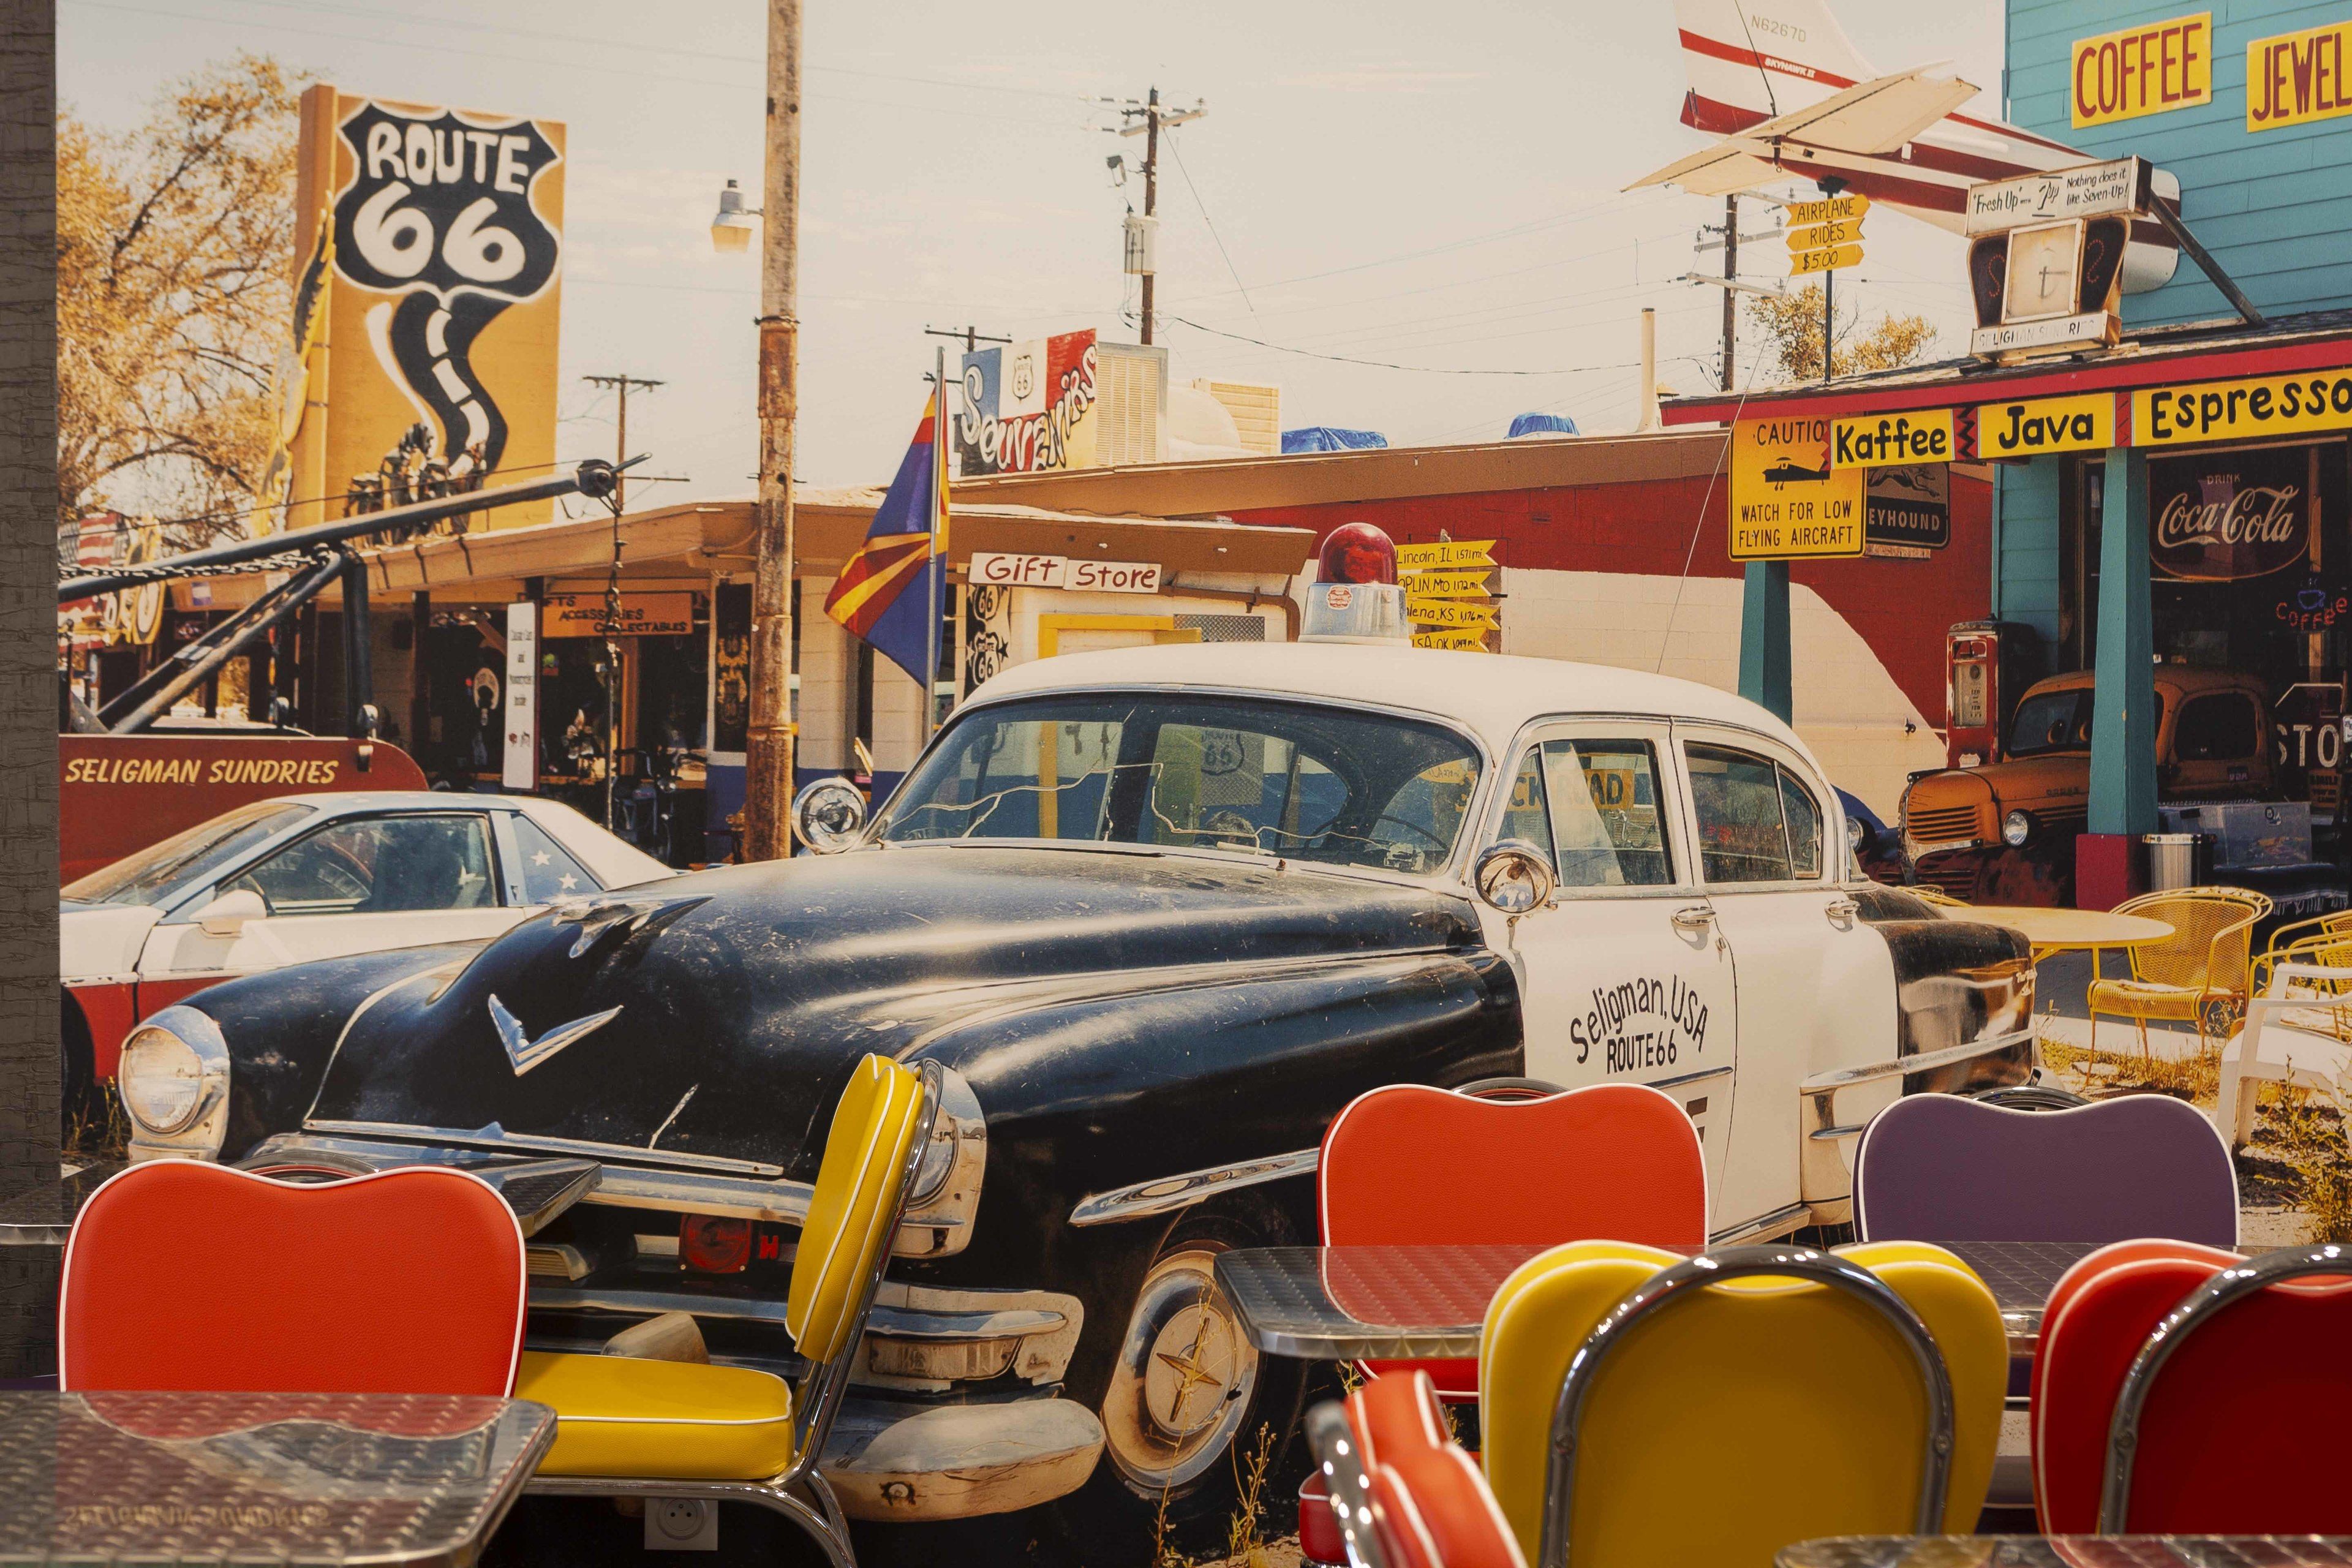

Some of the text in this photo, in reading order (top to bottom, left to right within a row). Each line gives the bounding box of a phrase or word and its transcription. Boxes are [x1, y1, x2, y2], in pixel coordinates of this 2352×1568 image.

[1751, 15, 1806, 42] N6267D
[2076, 23, 2203, 118] COFFEE
[2252, 32, 2352, 121] JEWEL
[368, 121, 531, 195] ROUTE
[2067, 167, 2127, 189] Nothing does it
[1796, 197, 1855, 222] AIRPLANE
[2067, 193, 2080, 206] like
[352, 181, 526, 283] 66
[1810, 223, 1845, 246] RIDES
[2150, 378, 2352, 439] Espresso
[1756, 419, 1825, 446] CAUTIO
[1837, 418, 1947, 464] Kaffee
[1999, 405, 2094, 450] Java
[2207, 473, 2241, 485] DRINK
[1741, 499, 1852, 523] WATCH FOR LOW
[1868, 508, 1940, 531] EYHOUND
[1738, 526, 1853, 548] FLYING AIRCRAFT
[984, 556, 1157, 589] Gift Store
[978, 590, 993, 613] 66
[1440, 607, 1455, 622] KS
[978, 656, 993, 678] 66
[64, 757, 339, 785] SELIGMAN SUNDRIES
[1607, 1029, 1678, 1074] ROUTE 66
